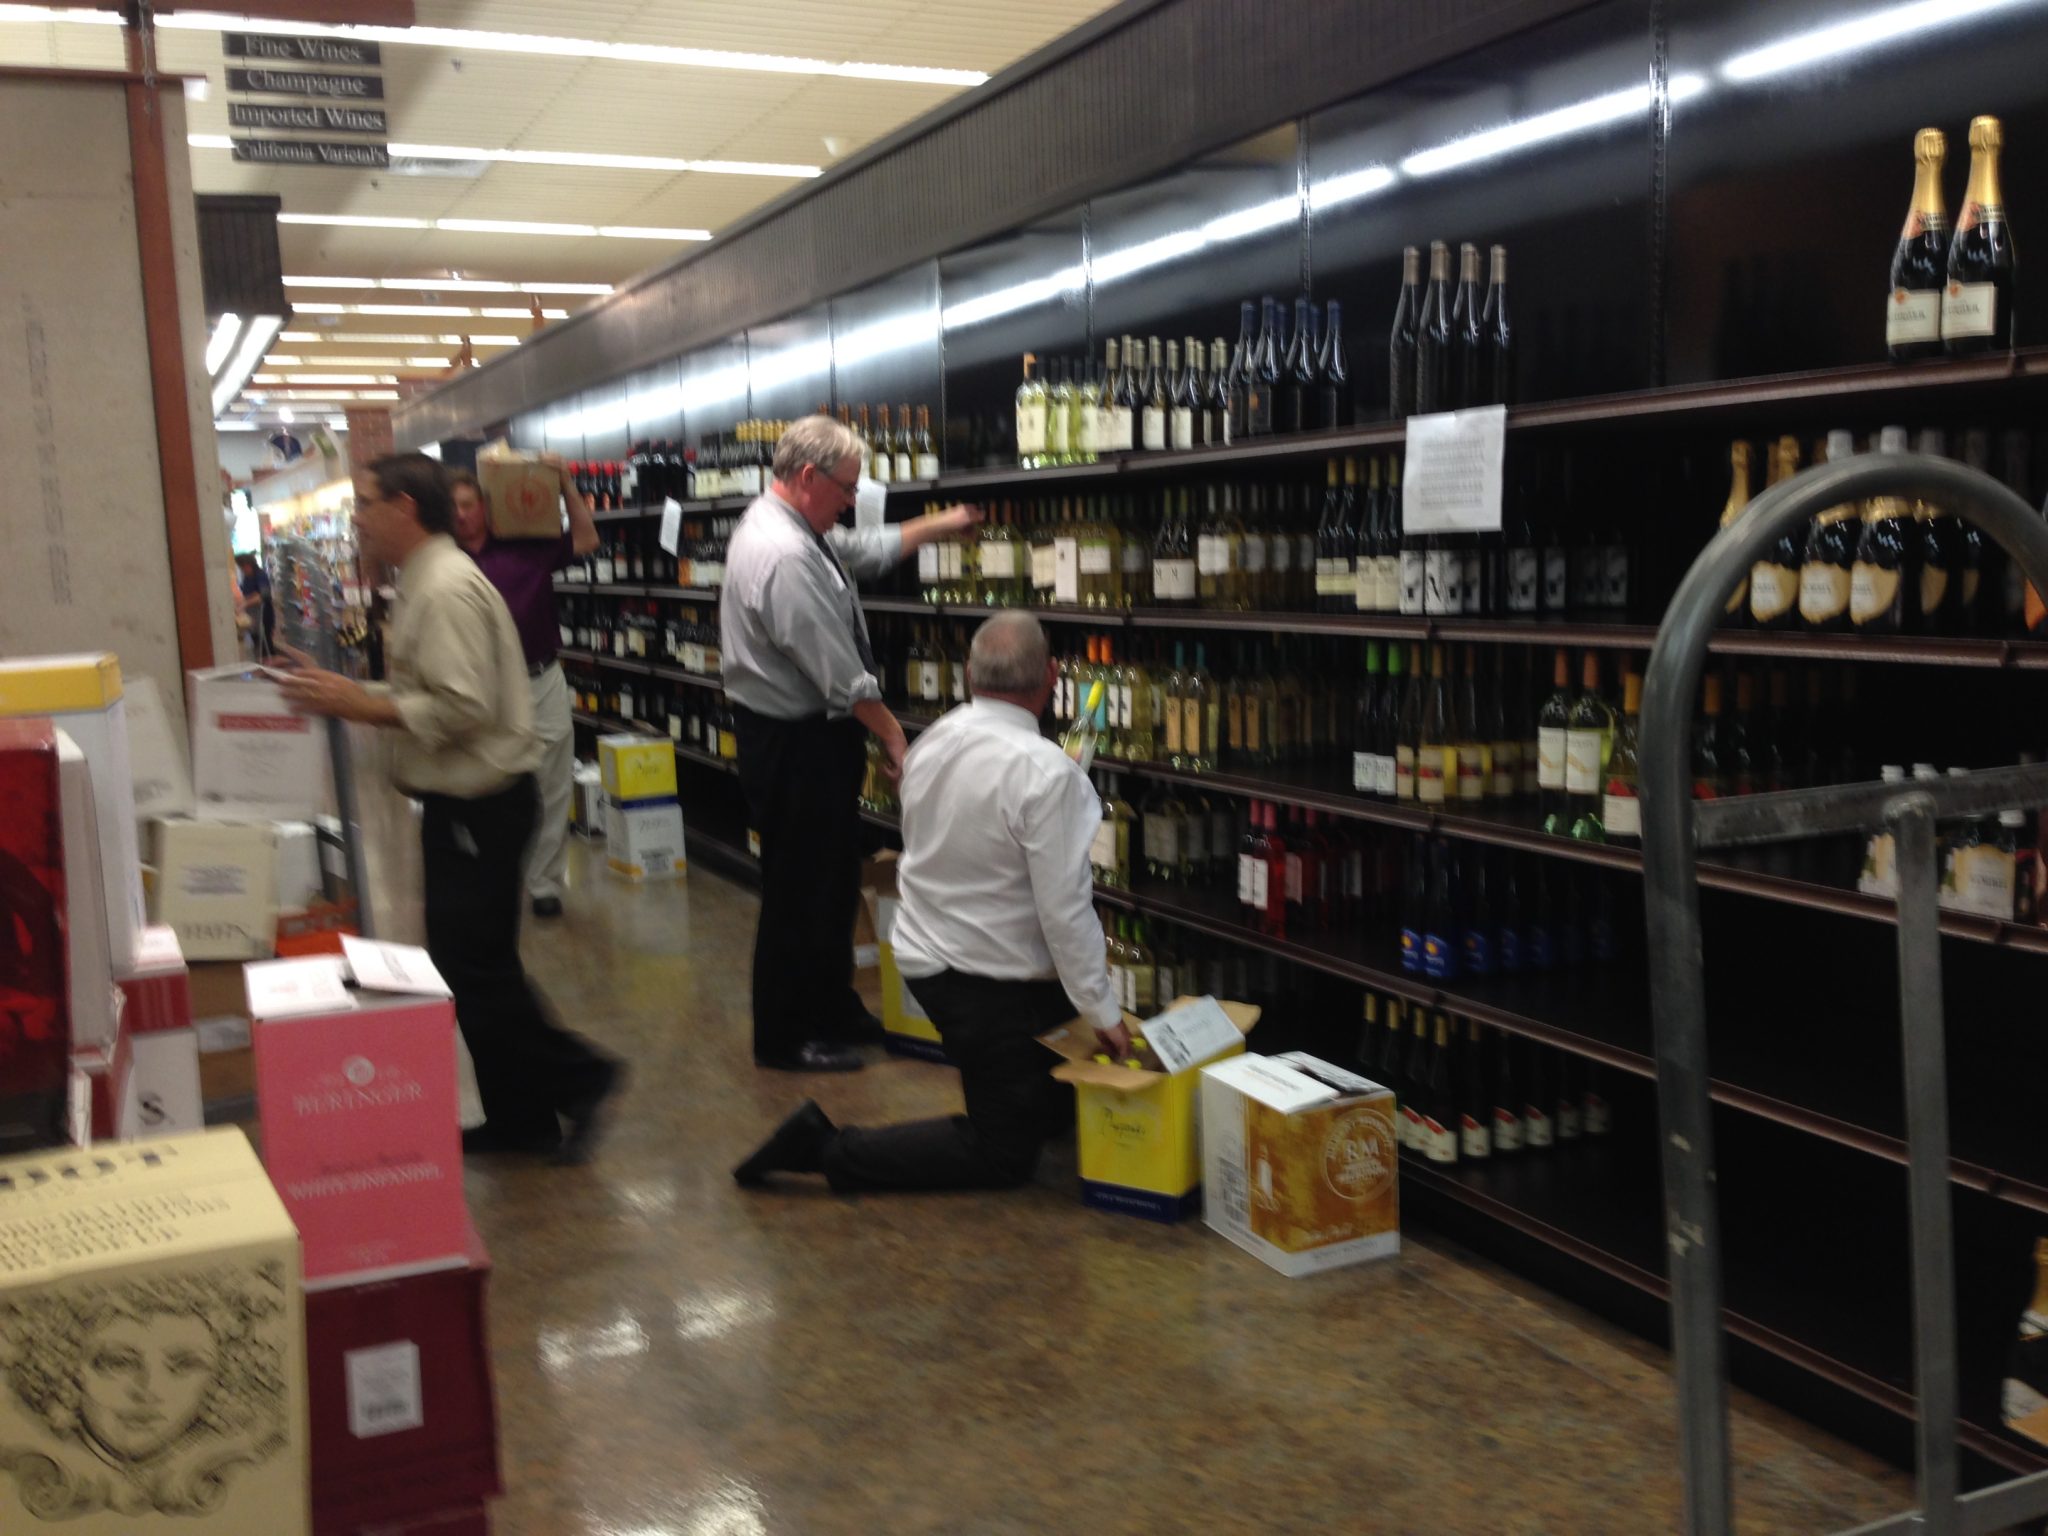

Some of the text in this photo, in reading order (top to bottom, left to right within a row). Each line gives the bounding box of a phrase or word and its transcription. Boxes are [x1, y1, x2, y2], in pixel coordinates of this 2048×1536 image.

[244, 34, 362, 60] Fine Wines
[247, 68, 367, 97] Champagne
[233, 103, 383, 129] Imported Wines
[236, 141, 313, 160] California
